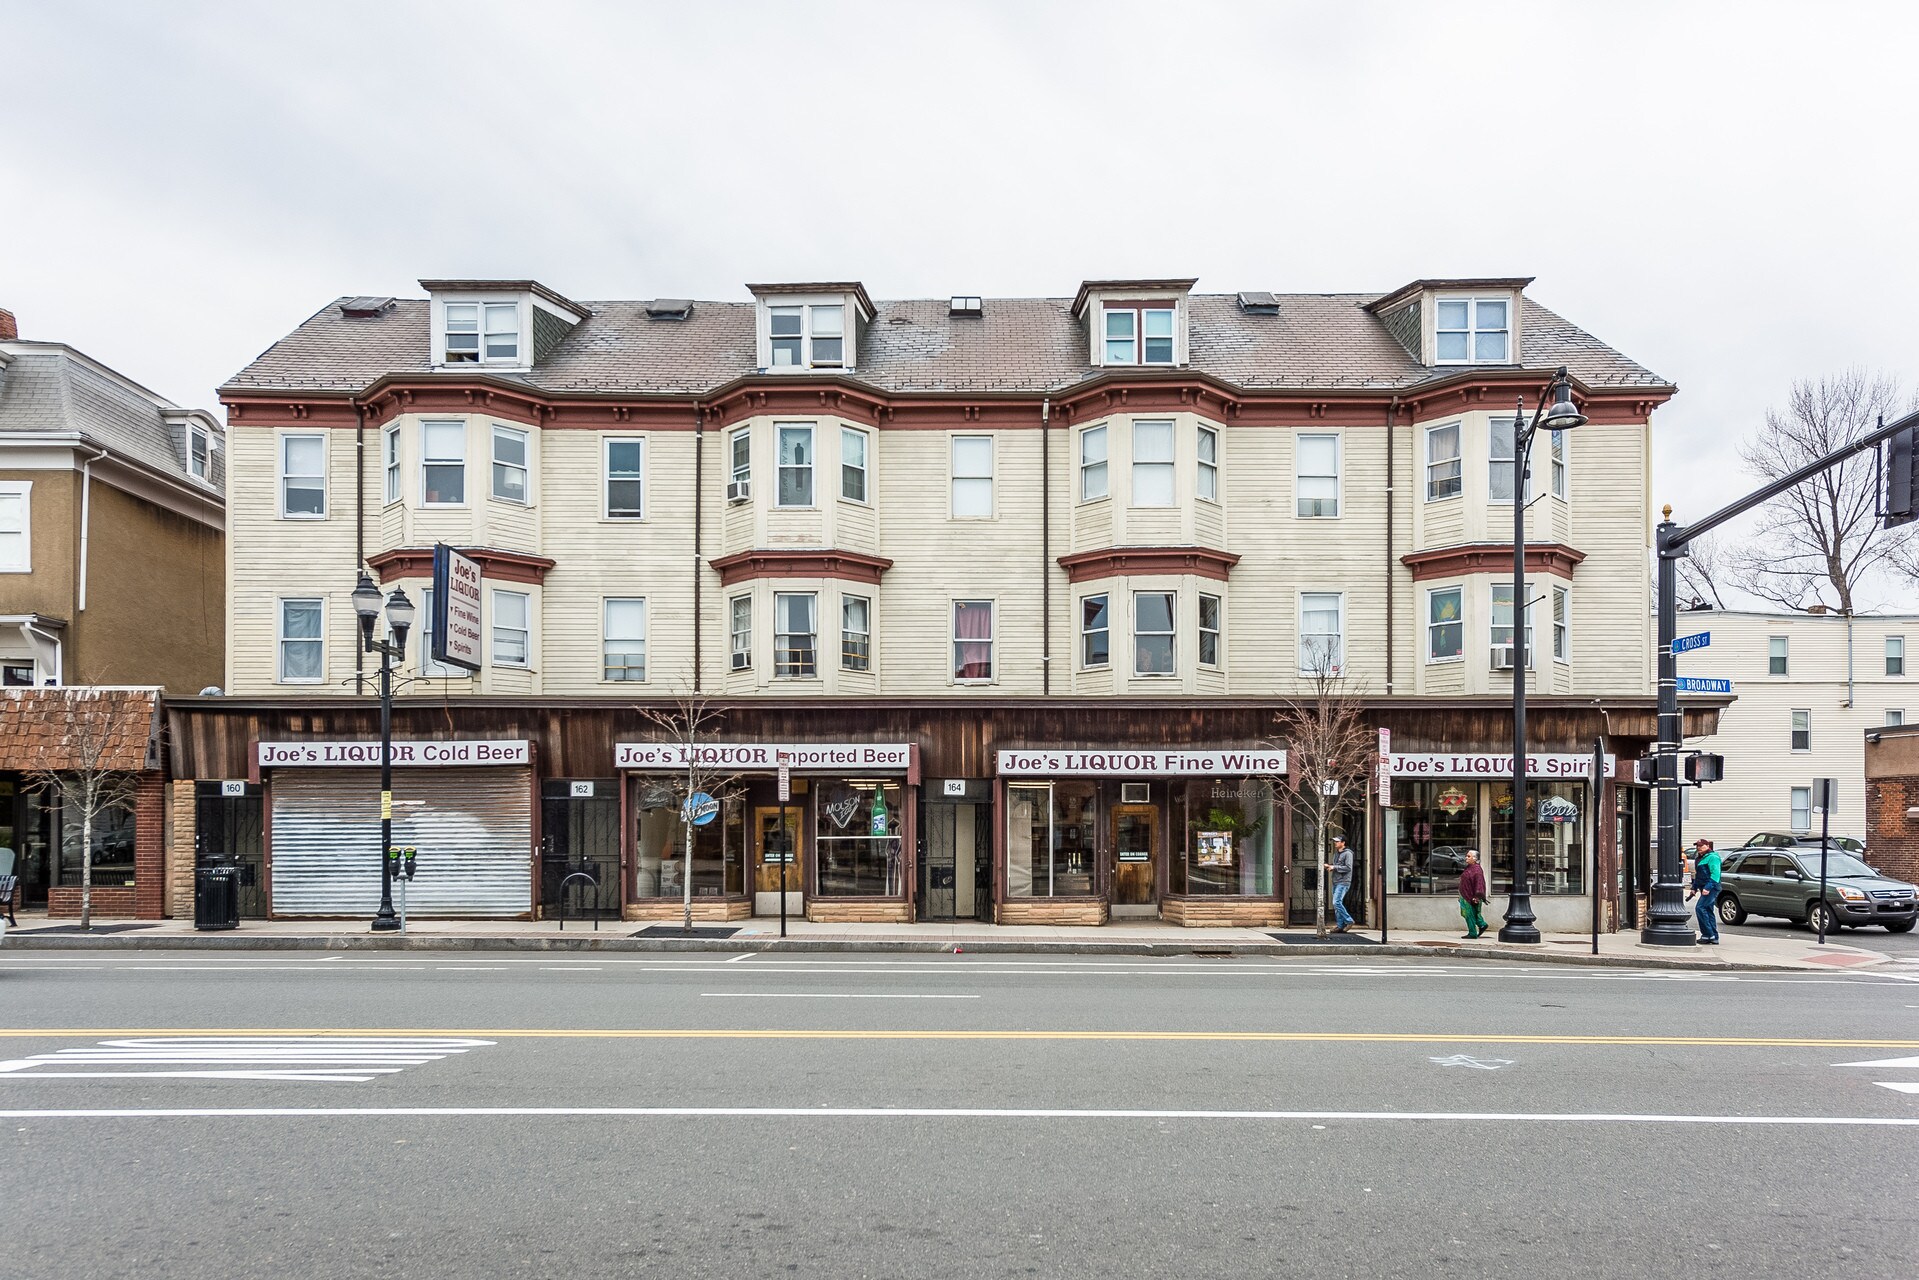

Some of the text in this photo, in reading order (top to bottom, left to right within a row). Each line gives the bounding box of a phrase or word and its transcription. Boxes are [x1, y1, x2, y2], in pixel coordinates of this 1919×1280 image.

[455, 559, 476, 583] Joe's
[450, 577, 480, 601] LIQUOR
[454, 606, 479, 624] Fine Wine
[454, 623, 480, 641] Cold Beer
[453, 640, 472, 655] Spirits
[1682, 635, 1708, 650] CROSS ST
[1686, 679, 1727, 691] BROADWAY
[263, 744, 523, 762] Joe's LIQUOR Cold Beer
[620, 747, 672, 763] Joe's
[679, 747, 768, 763] LIQUOR
[863, 748, 905, 763] Beer
[1005, 754, 1280, 770] Joe's LIQUOR Fine Wine
[1393, 756, 1445, 773] Joe's
[1546, 758, 1610, 777] Spiris
[226, 783, 241, 793] 160
[575, 784, 588, 793] 162
[948, 783, 961, 792] 164
[1211, 788, 1264, 798] Heineken
[826, 795, 860, 815] MOLSON
[1540, 799, 1578, 816] Coors
